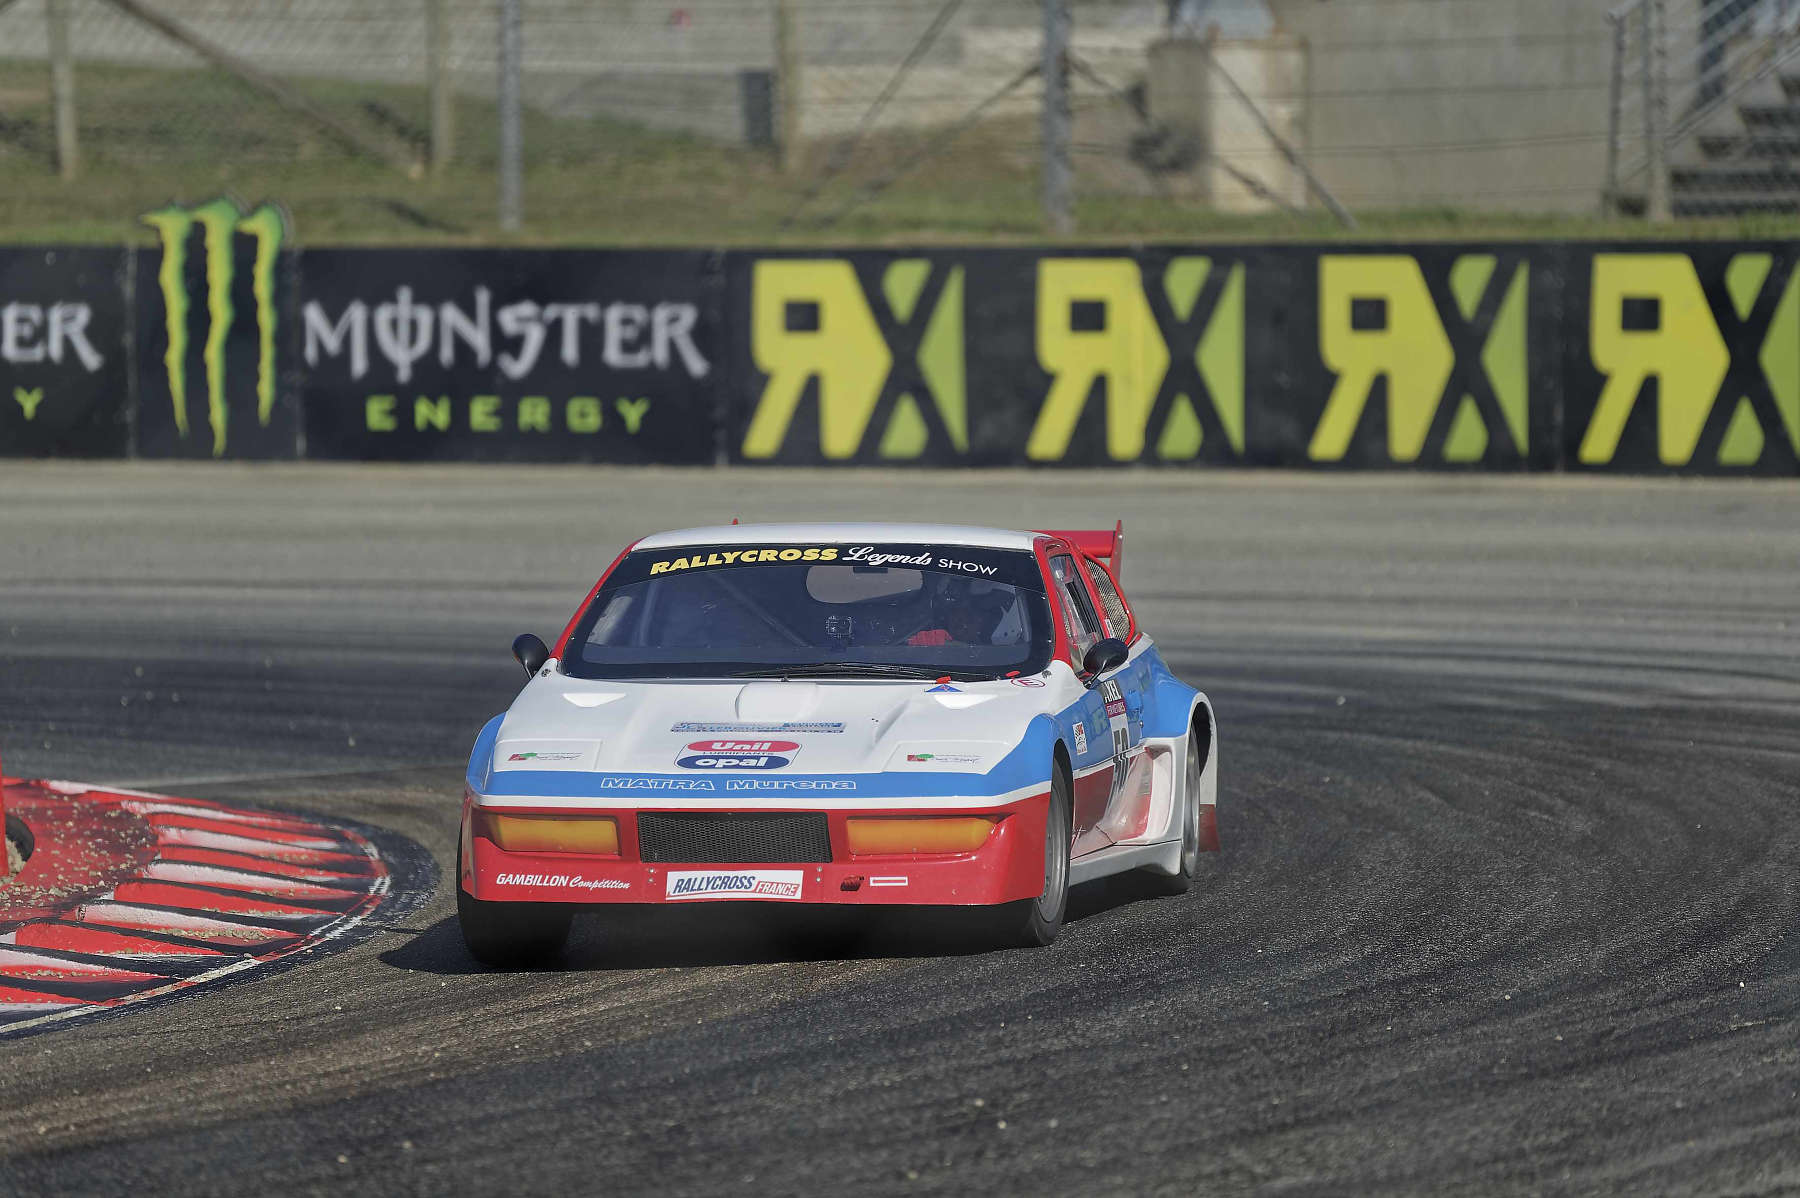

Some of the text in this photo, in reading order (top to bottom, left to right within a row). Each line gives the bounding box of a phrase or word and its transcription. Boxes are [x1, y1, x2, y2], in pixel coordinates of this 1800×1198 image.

[303, 285, 710, 383] MONSTER
[741, 259, 969, 460] RX
[1025, 256, 1246, 461] RX
[1306, 253, 1530, 463] RX
[1577, 252, 1800, 466] RX
[365, 394, 651, 434] ENERGY
[650, 546, 998, 576] RALLYCROSS Legends SHOW
[695, 756, 768, 768] opal
[711, 742, 773, 751] Unil
[600, 777, 857, 791] MATRA Murena
[496, 873, 570, 887] GAMBILLON
[673, 875, 799, 897] RALLYCROSS FRANCE
